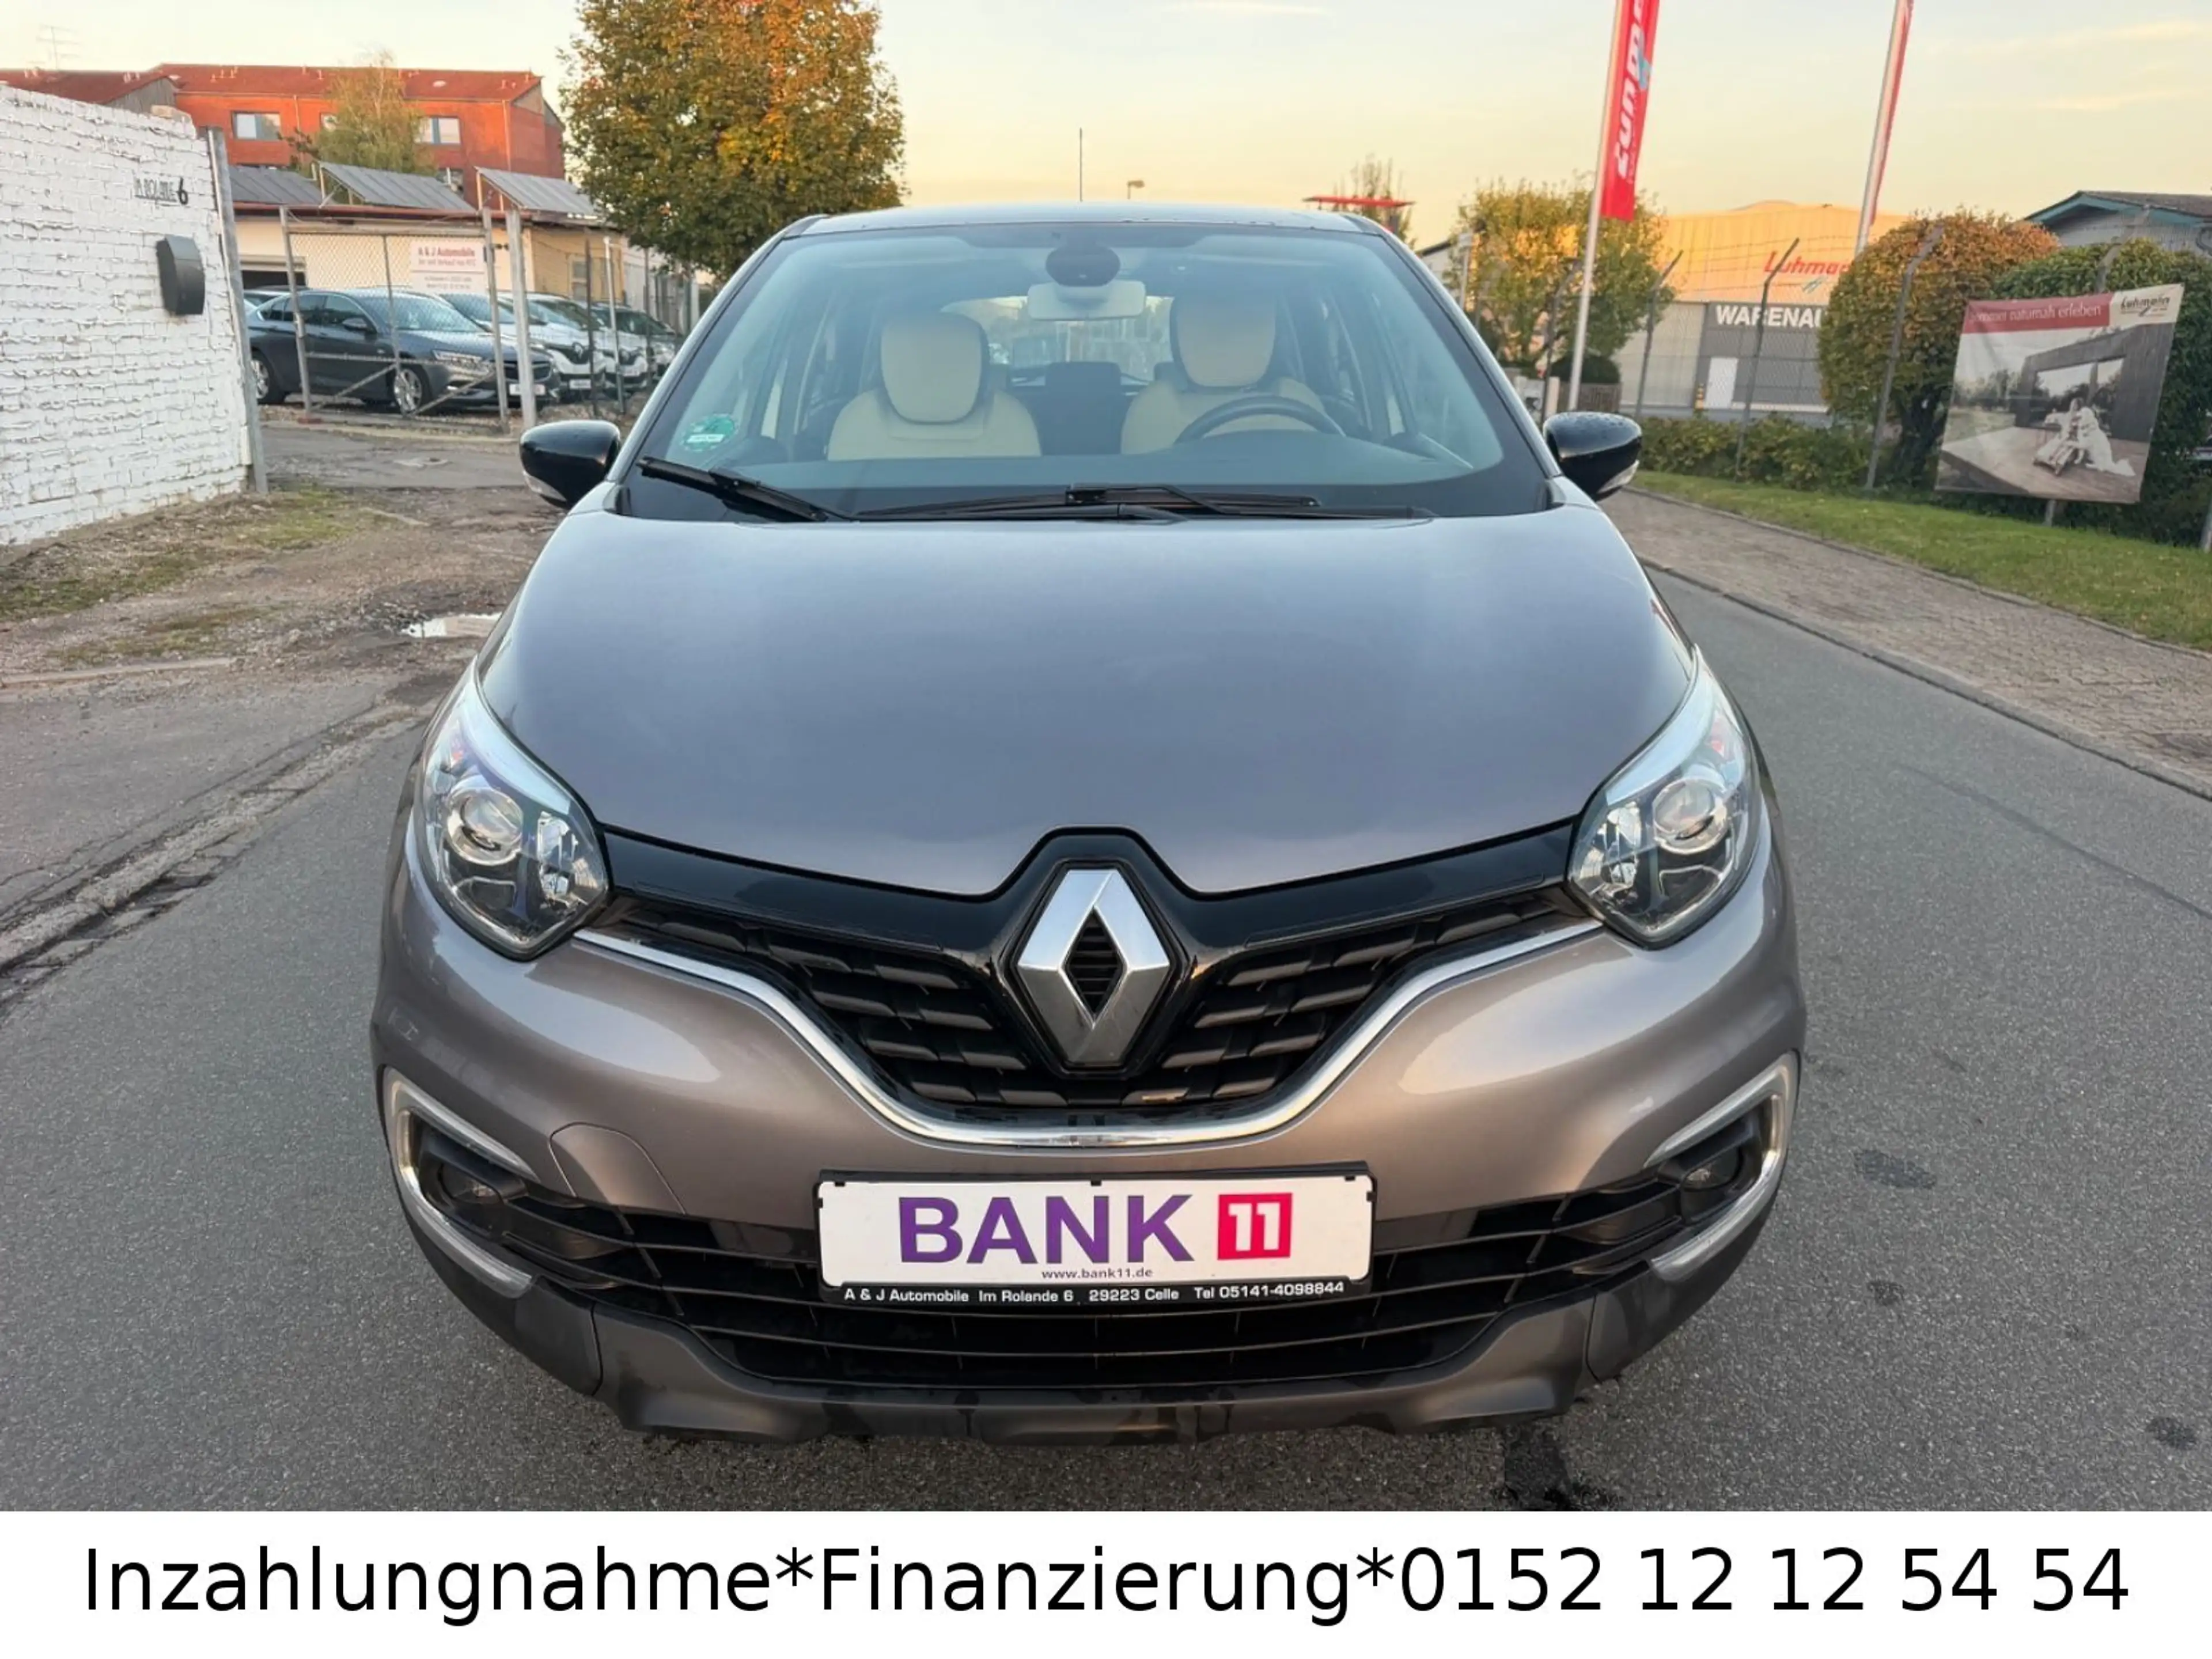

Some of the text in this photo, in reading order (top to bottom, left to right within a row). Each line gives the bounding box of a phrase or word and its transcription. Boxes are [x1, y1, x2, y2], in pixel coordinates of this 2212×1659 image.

[176, 177, 188, 205] 6
[2058, 301, 2101, 318] erleben
[899, 1194, 1281, 1264] BANK 11
[1041, 1267, 1153, 1279] www.bank11.de
[844, 1282, 1344, 1302] A & J Automobile Im Rolande 6 29223 Celle Tel 05141-4098844
